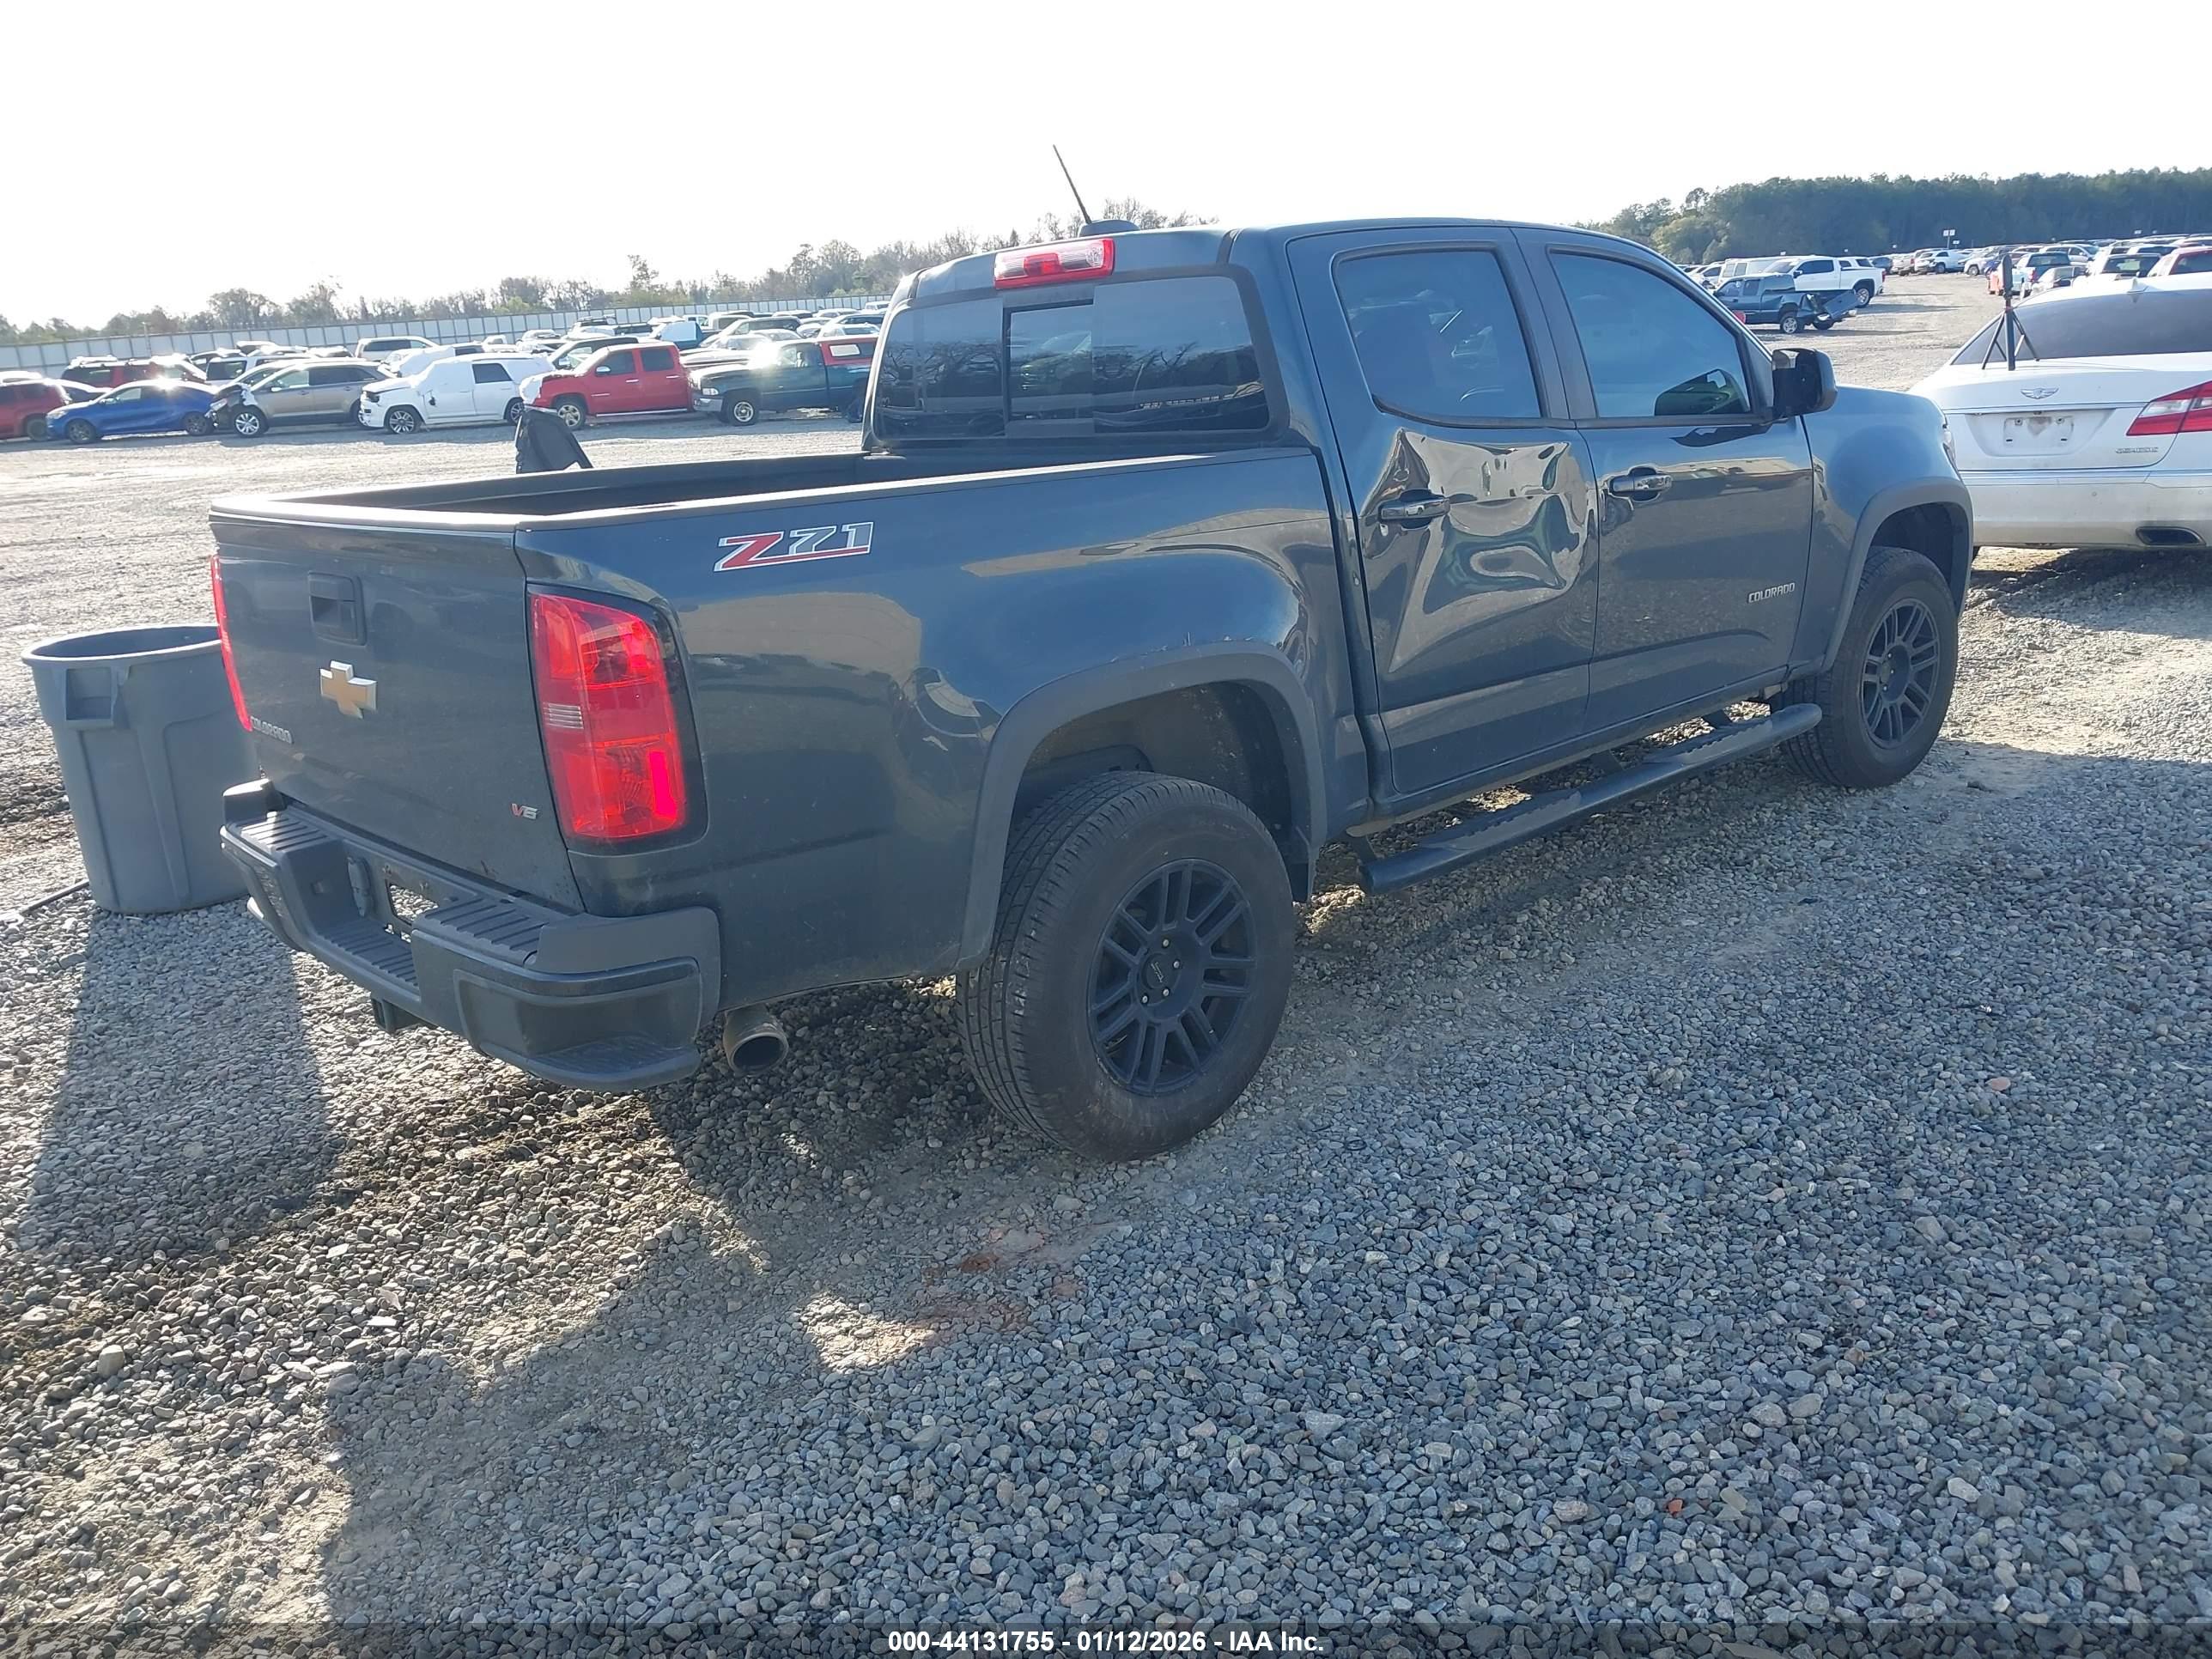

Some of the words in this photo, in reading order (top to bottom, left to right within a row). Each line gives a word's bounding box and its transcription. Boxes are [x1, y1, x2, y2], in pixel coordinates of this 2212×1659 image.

[714, 521, 874, 572] Z71
[1747, 582, 1796, 603] COLORADO
[511, 803, 538, 819] V6
